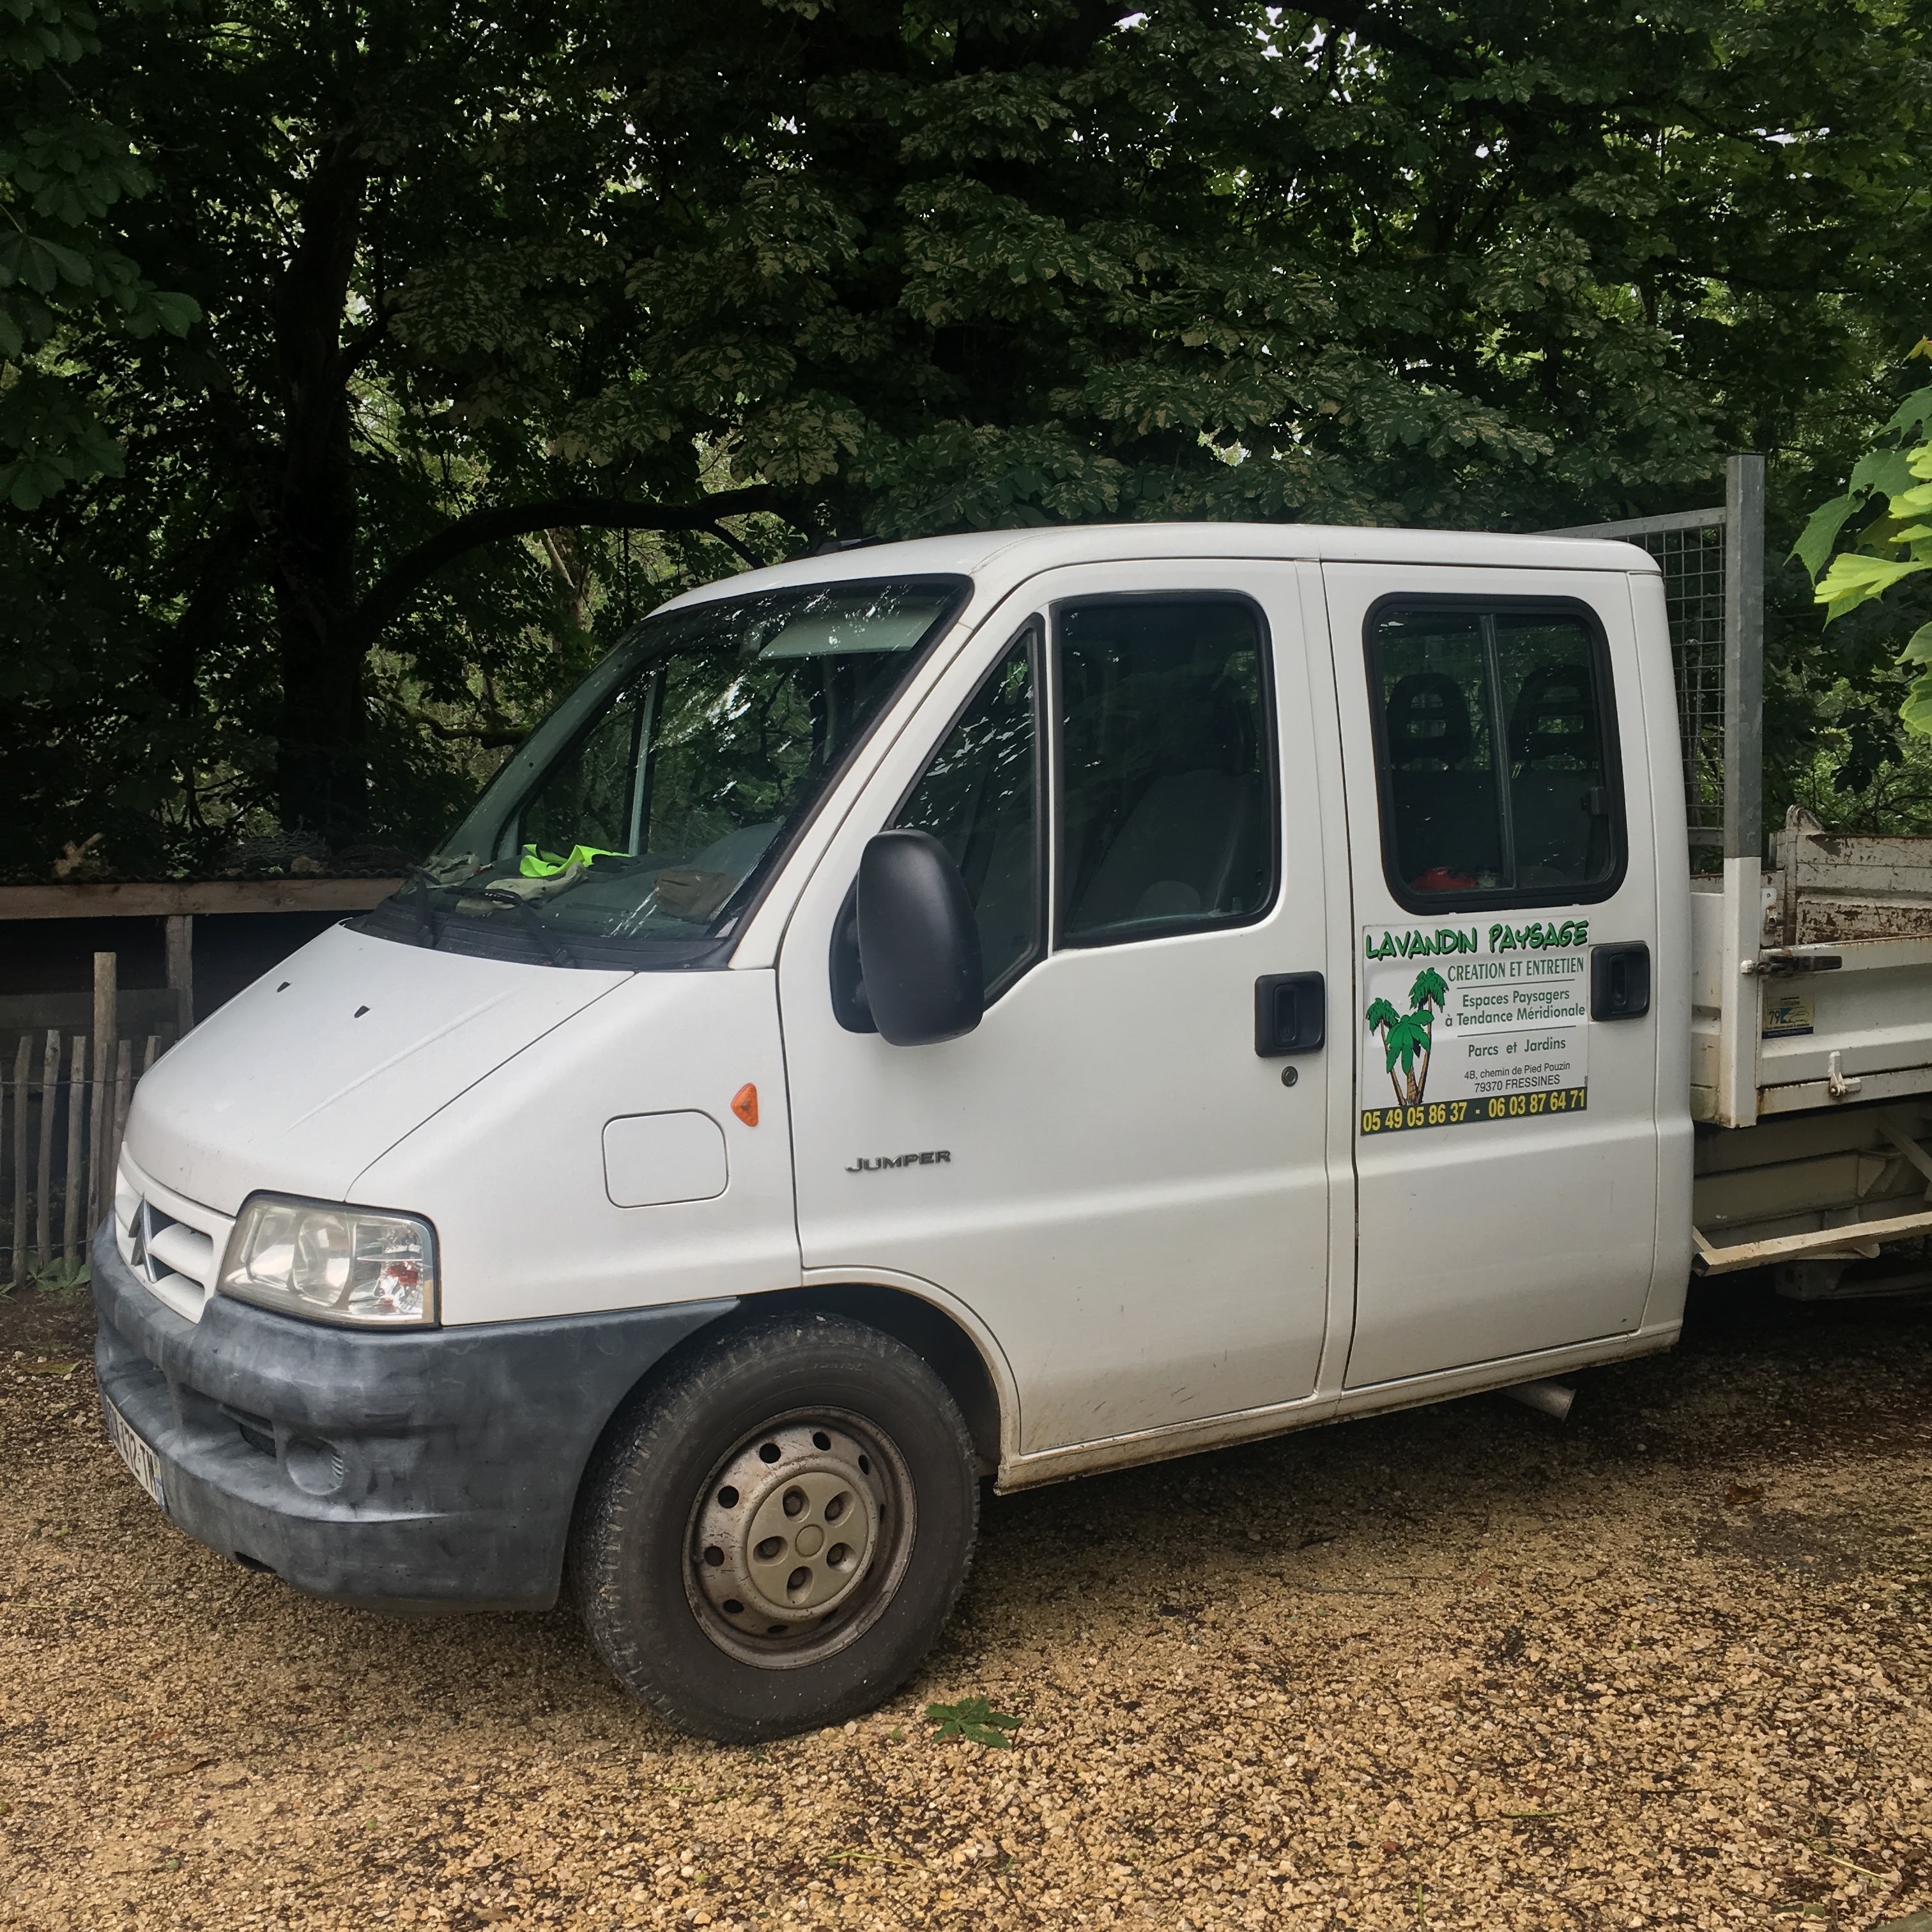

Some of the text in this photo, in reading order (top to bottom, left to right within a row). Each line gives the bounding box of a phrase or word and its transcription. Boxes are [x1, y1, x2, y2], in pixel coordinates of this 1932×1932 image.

[1366, 920, 1588, 961] LAVANDIN PAYSAGE
[1448, 957, 1584, 982] CREATION ET ENTRETIEN
[1462, 988, 1570, 1009] Espaces Paysagers
[1445, 1003, 1585, 1027] à Tendance Méridionale
[1769, 1010, 1780, 1025] 79
[1468, 1038, 1566, 1057] Parcs et Jardins
[1464, 1062, 1570, 1080] 4B, chemin de Pied Pouzin
[1475, 1075, 1560, 1093] 79370 FRESSINES
[1363, 1111, 1381, 1132] 05
[1385, 1109, 1403, 1130] 49
[1407, 1107, 1423, 1127] 05
[1429, 1104, 1446, 1124] 86
[1450, 1102, 1468, 1122] 37
[1488, 1098, 1505, 1118] 06
[1510, 1096, 1526, 1116] 03
[1529, 1094, 1545, 1113] 87
[1550, 1092, 1566, 1111] 64
[1570, 1089, 1584, 1108] 71
[845, 1150, 951, 1172] JUMPER
